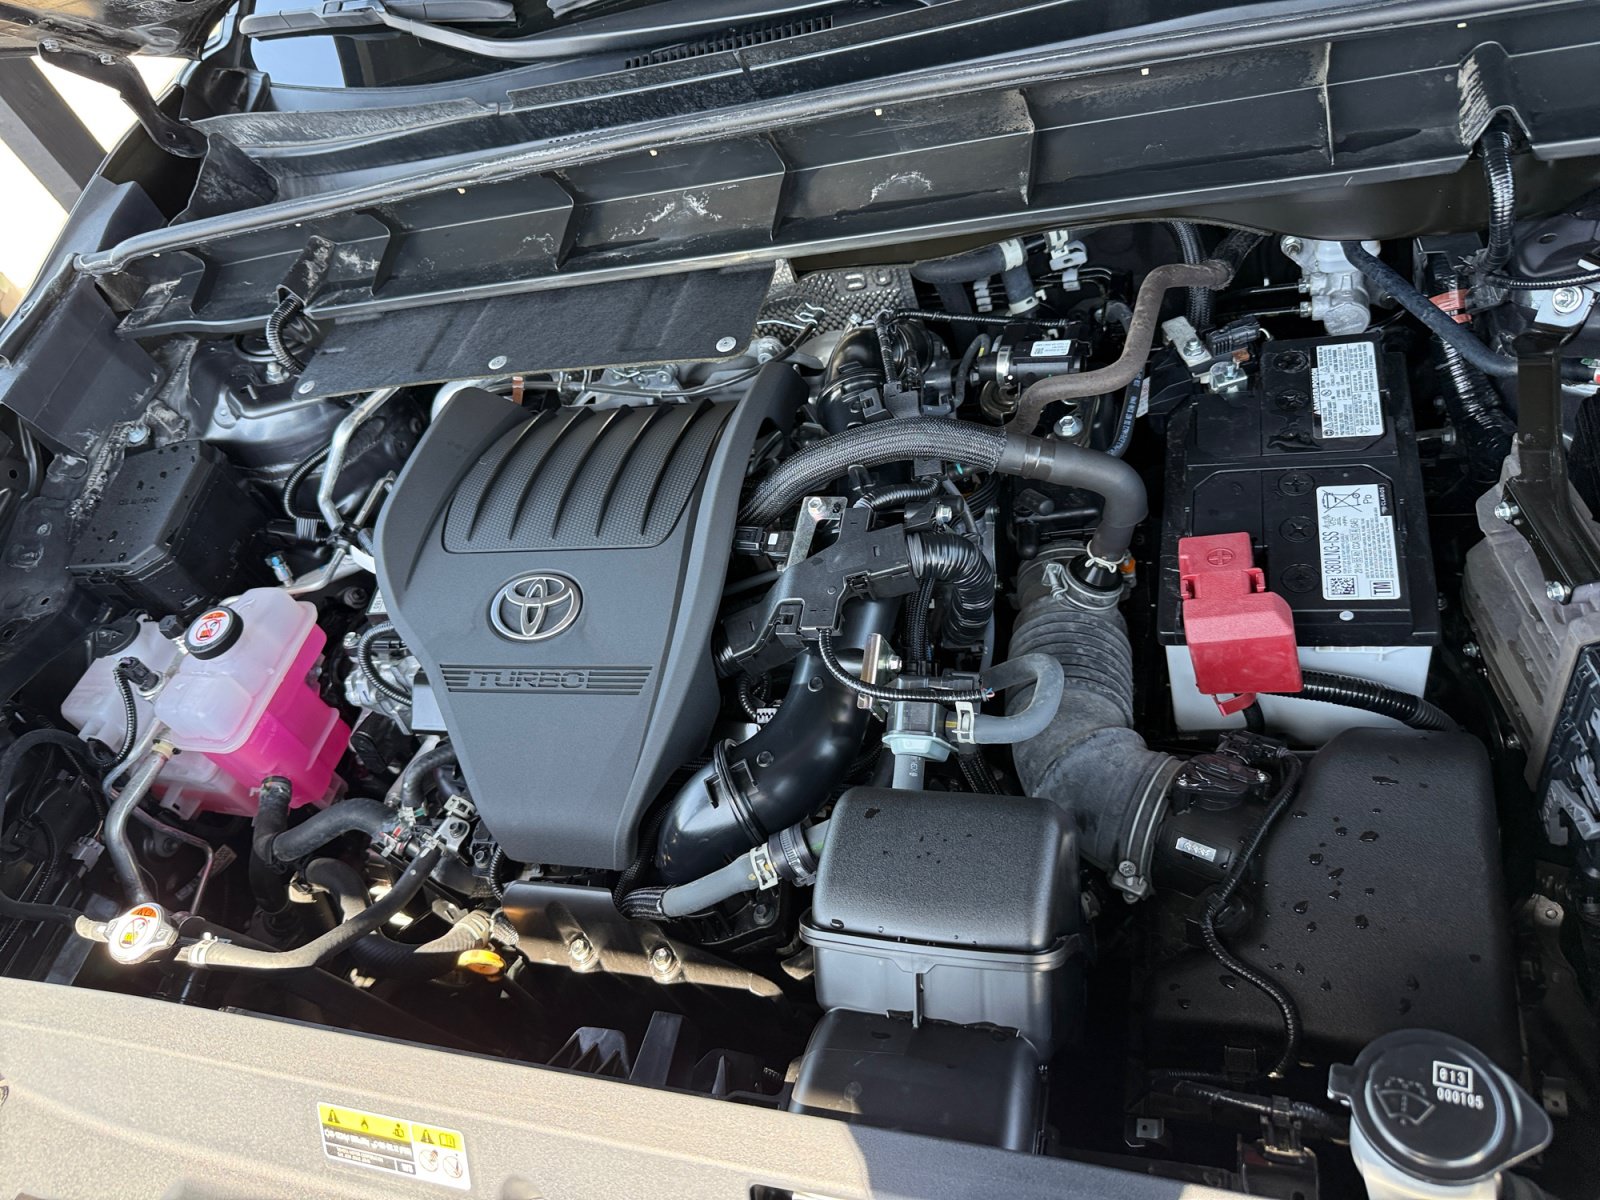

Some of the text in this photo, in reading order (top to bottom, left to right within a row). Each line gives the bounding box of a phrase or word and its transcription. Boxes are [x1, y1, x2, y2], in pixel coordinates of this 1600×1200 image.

[1322, 531, 1341, 574] 380LN3-ISS
[1372, 582, 1392, 595] TM
[472, 670, 585, 688] TURBO
[1437, 1086, 1484, 1110] 000105
